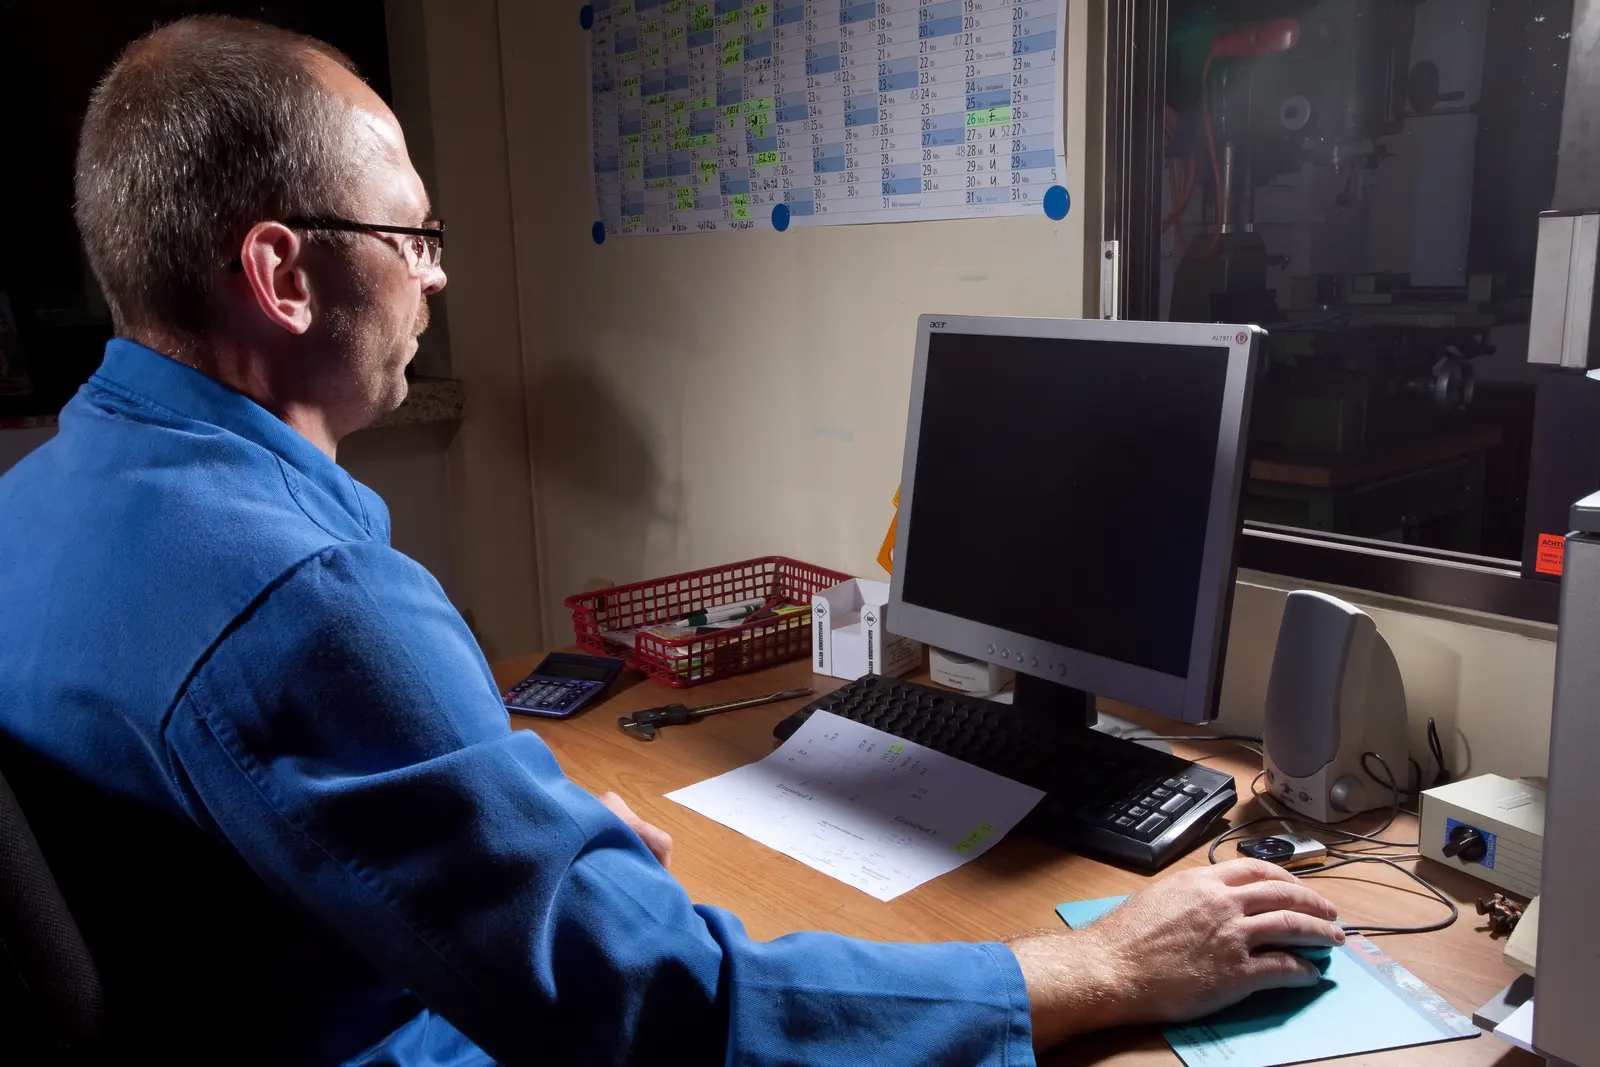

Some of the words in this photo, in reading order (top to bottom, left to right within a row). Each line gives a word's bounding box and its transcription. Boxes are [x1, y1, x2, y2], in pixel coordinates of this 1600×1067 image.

[878, 2, 886, 14] 18
[964, 0, 974, 12] 19
[920, 10, 928, 22] 19
[1012, 7, 1022, 20] 20
[878, 18, 886, 30] 19
[964, 16, 974, 29] 20
[840, 27, 848, 38] 19
[919, 25, 928, 38] 20
[1013, 24, 1022, 37] 21
[878, 34, 886, 46] 20
[965, 33, 973, 46] 21
[841, 42, 848, 54] 20
[920, 41, 927, 53] 21
[1013, 41, 1022, 54] 22
[878, 49, 885, 60] 21
[965, 49, 974, 62] 22
[842, 57, 848, 68] 21
[920, 57, 928, 68] 22
[1013, 58, 1022, 70] 23
[879, 64, 886, 76] 22
[966, 66, 974, 78] 23
[842, 71, 850, 82] 22
[920, 72, 928, 84] 23
[1013, 74, 1022, 87] 24
[879, 79, 887, 90] 23
[966, 82, 975, 94] 24
[844, 86, 851, 97] 23
[921, 88, 930, 100] 24
[1013, 91, 1022, 104] 25
[844, 100, 852, 112] 24
[880, 94, 888, 106] 24
[966, 97, 976, 110] 25
[880, 109, 888, 120] 25
[921, 104, 930, 115] 25
[1012, 107, 1022, 120] 26
[922, 118, 930, 130] 26
[966, 113, 976, 125] 26
[846, 130, 853, 140] 26
[881, 124, 889, 136] 26
[967, 129, 976, 141] 27
[1012, 124, 1021, 136] 27
[881, 139, 889, 150] 27
[922, 134, 931, 146] 27
[1012, 140, 1020, 152] 28
[846, 144, 853, 154] 27
[922, 149, 932, 160] 28
[967, 145, 976, 156] 28
[846, 158, 854, 168] 28
[882, 154, 890, 165] 28
[1012, 156, 1020, 168] 29
[922, 165, 932, 176] 29
[967, 161, 976, 172] 29
[847, 172, 854, 182] 29
[882, 168, 890, 180] 29
[1012, 172, 1020, 184] 30
[923, 180, 932, 190] 30
[966, 176, 976, 188] 30
[848, 186, 855, 197] 30
[882, 183, 890, 194] 30
[1012, 188, 1020, 200] 31
[883, 198, 890, 208] 31
[966, 192, 974, 203] 31
